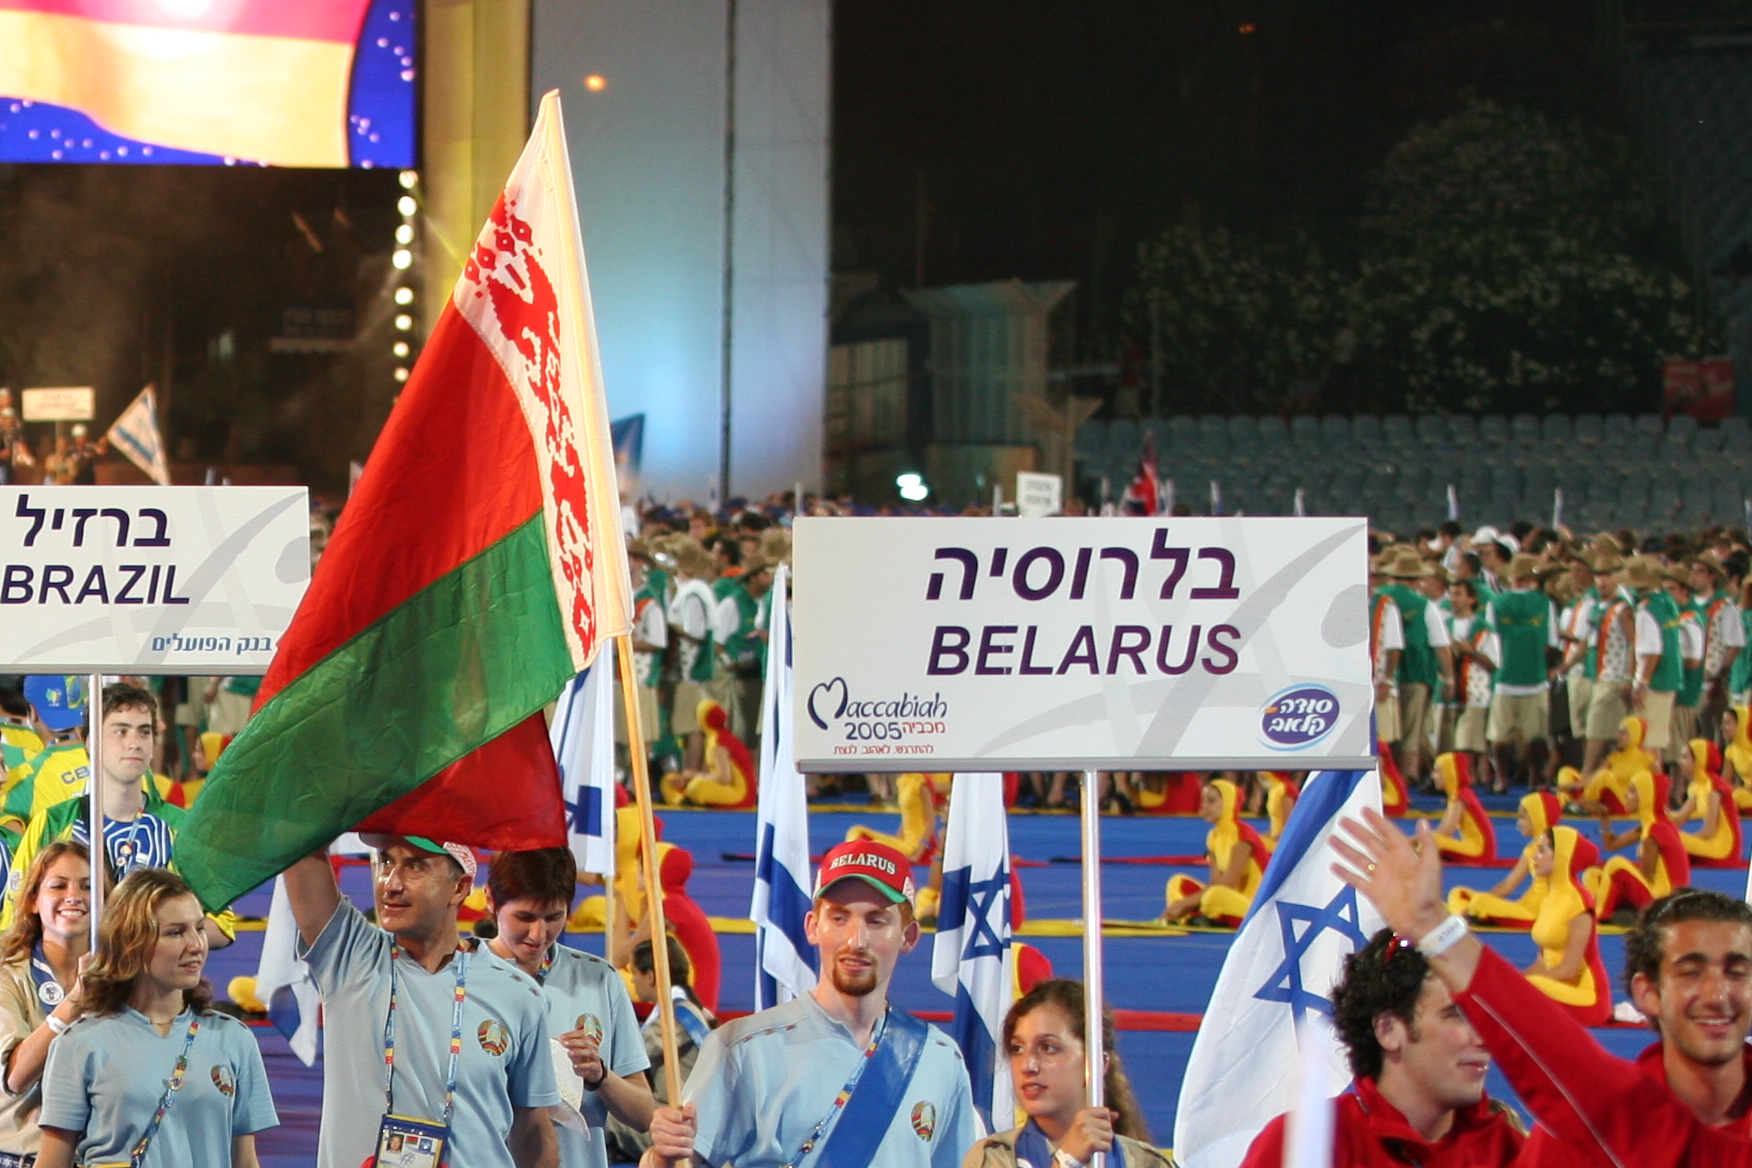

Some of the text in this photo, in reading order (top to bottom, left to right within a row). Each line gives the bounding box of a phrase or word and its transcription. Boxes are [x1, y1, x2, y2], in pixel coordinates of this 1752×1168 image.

[15, 494, 171, 547] ברזיל
[925, 528, 1240, 601] בלרוסיה
[0, 565, 190, 605] BRAZIL
[152, 633, 272, 655] בנק הפועלים
[926, 624, 1241, 676] BELARUS
[807, 677, 947, 730] Maccabiah
[1279, 698, 1333, 714] סודה
[844, 721, 946, 740] 2005 מכביה
[1268, 714, 1326, 736] קלאב
[829, 853, 897, 875] BELARUS
